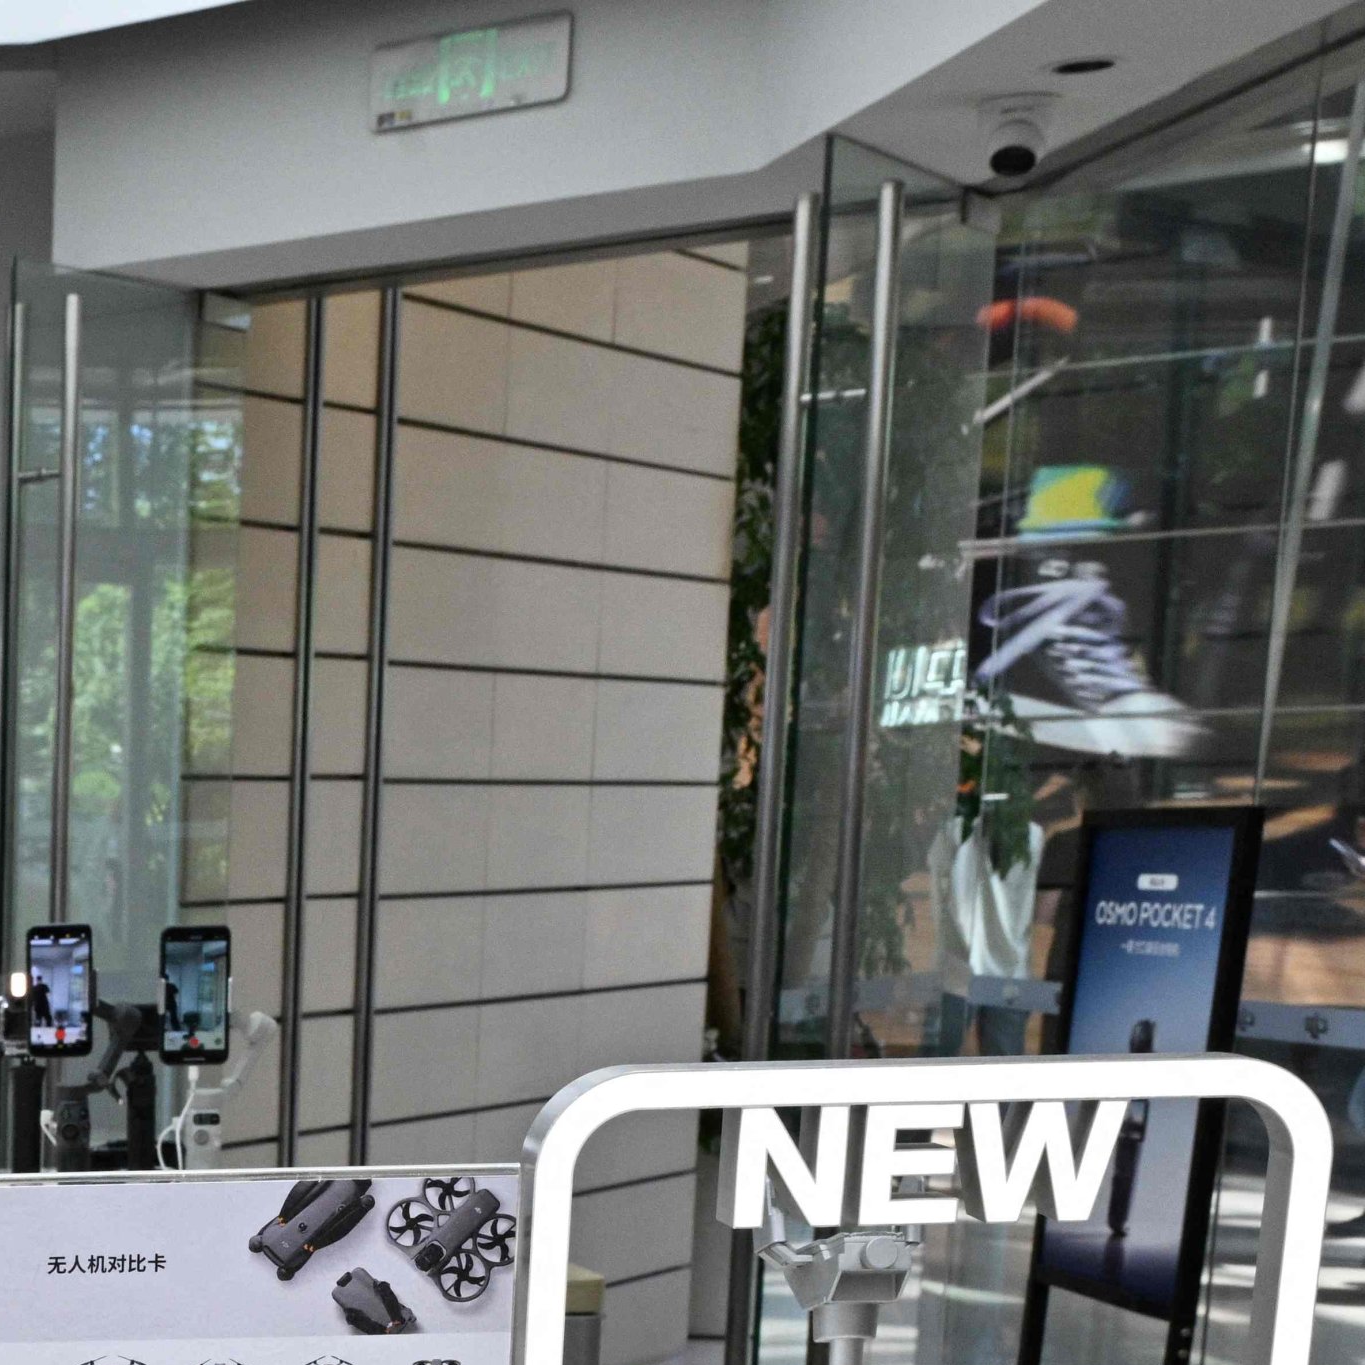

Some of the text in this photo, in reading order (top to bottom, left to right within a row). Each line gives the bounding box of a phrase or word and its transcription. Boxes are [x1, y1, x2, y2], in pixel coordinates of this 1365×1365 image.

[1095, 901, 1217, 930] OSMO POCKET 4
[730, 1099, 1128, 1229] NEW
[47, 1253, 167, 1274] 无人机对比卡
